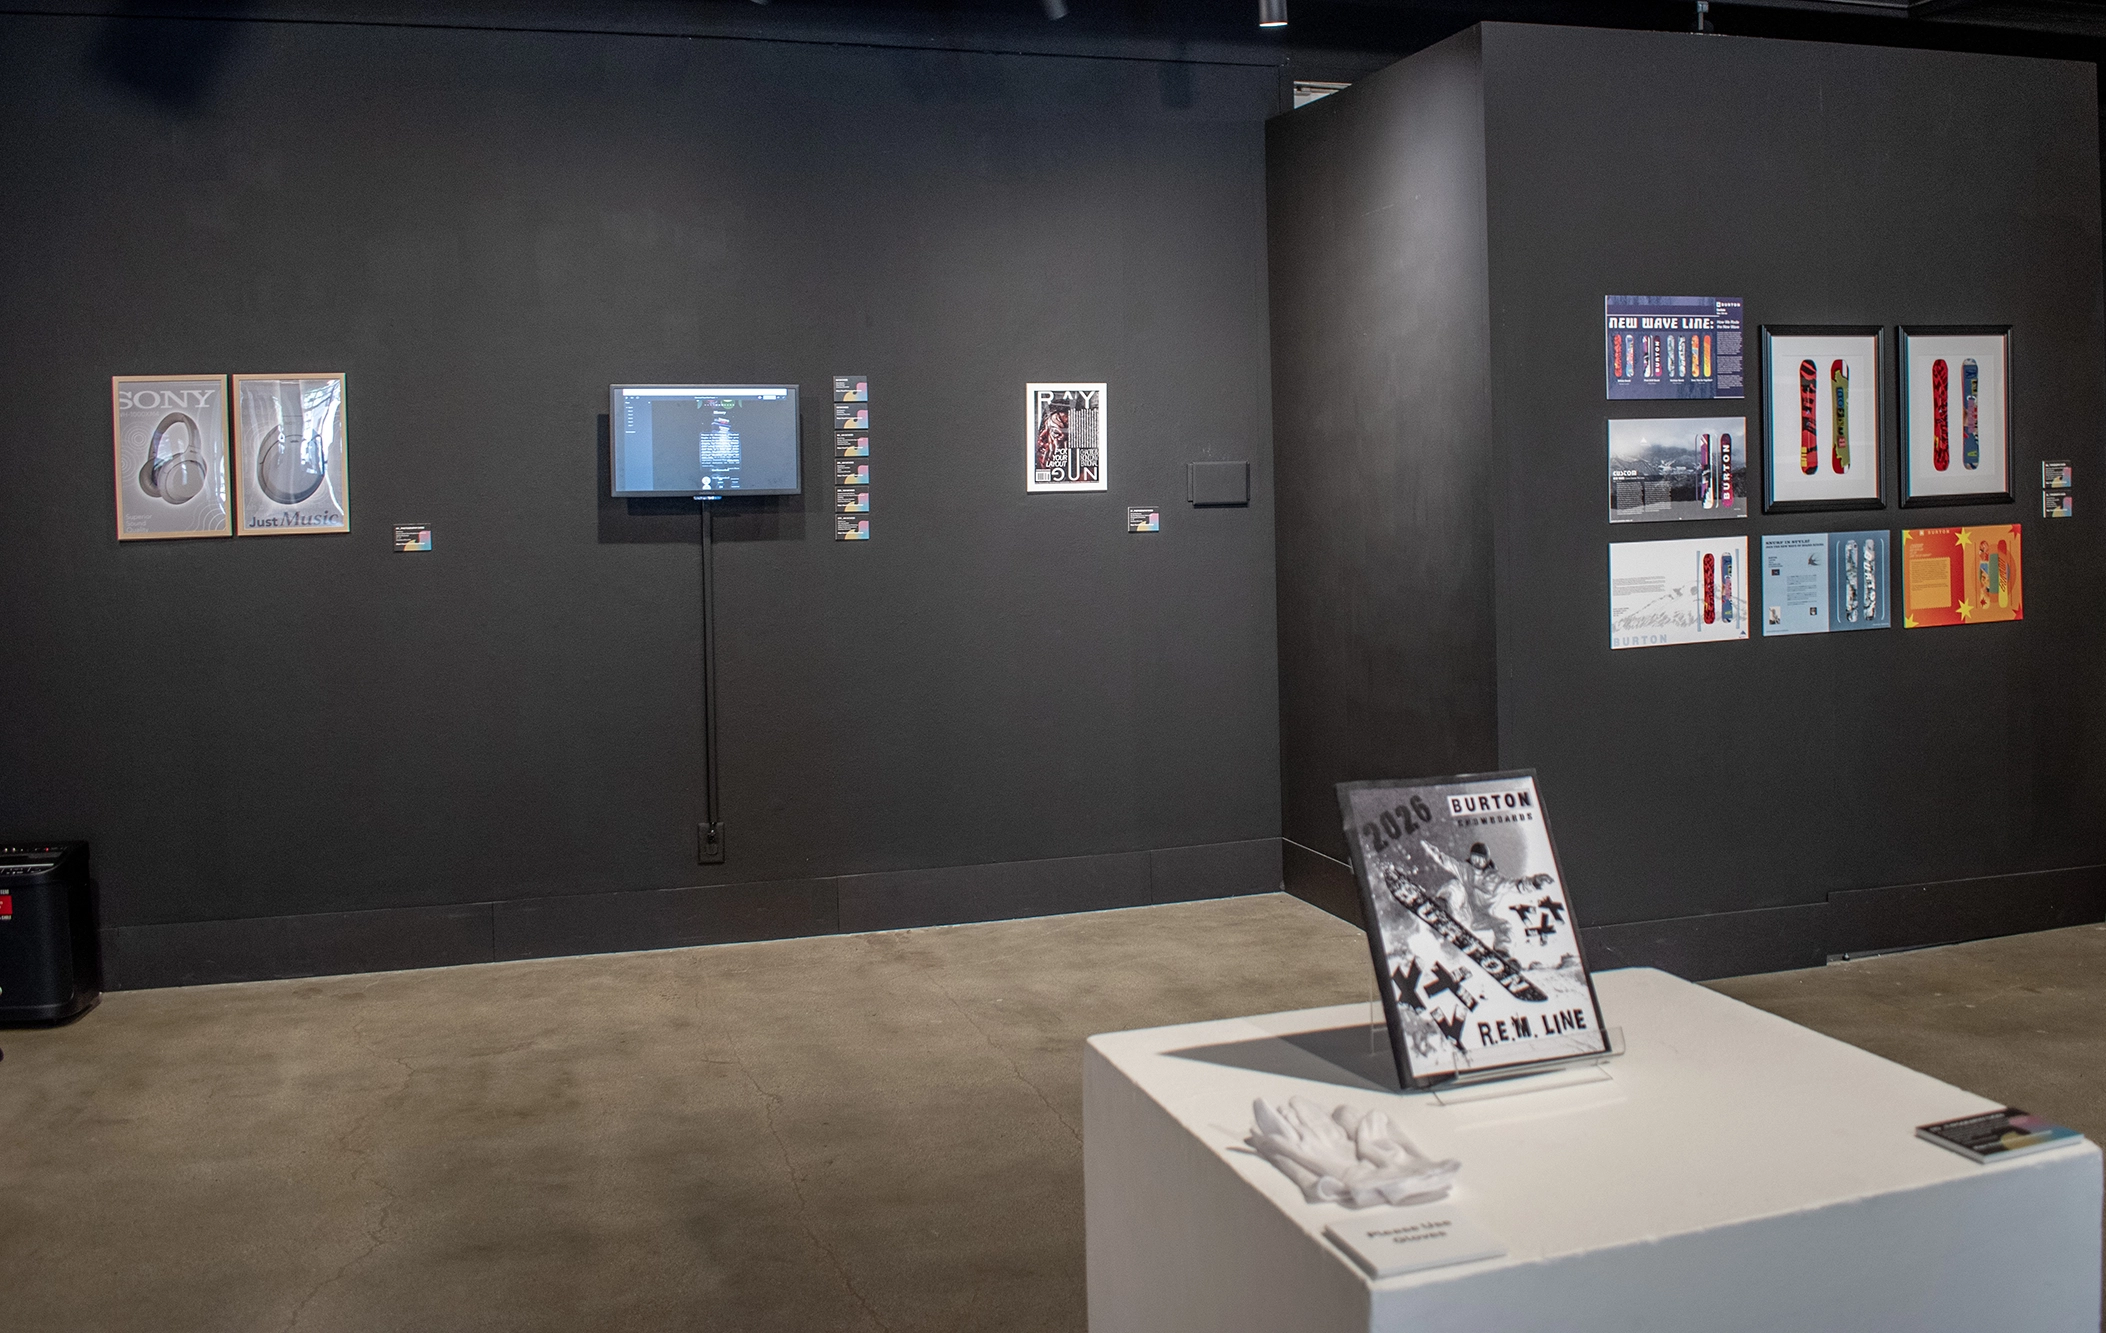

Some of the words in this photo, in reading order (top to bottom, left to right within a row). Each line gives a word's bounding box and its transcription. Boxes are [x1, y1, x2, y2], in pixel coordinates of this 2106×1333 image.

[1609, 318, 1638, 329] NEW
[1642, 318, 1678, 329] WAVE
[1682, 318, 1715, 330] LINE:
[119, 390, 216, 410] SONY
[1052, 448, 1098, 482] GUN
[1722, 444, 1731, 500] BURTON
[249, 516, 278, 527] Just
[280, 510, 339, 526] Music
[1613, 634, 1668, 647] BURTON
[1451, 791, 1532, 814] BURTON
[1362, 794, 1433, 854] 2026
[1457, 813, 1534, 828] SNOWBOARDS
[1542, 1008, 1587, 1036] LINE
[1367, 1224, 1419, 1238] Please
[1420, 1220, 1452, 1230] Use
[1393, 1230, 1447, 1244] Gloves
